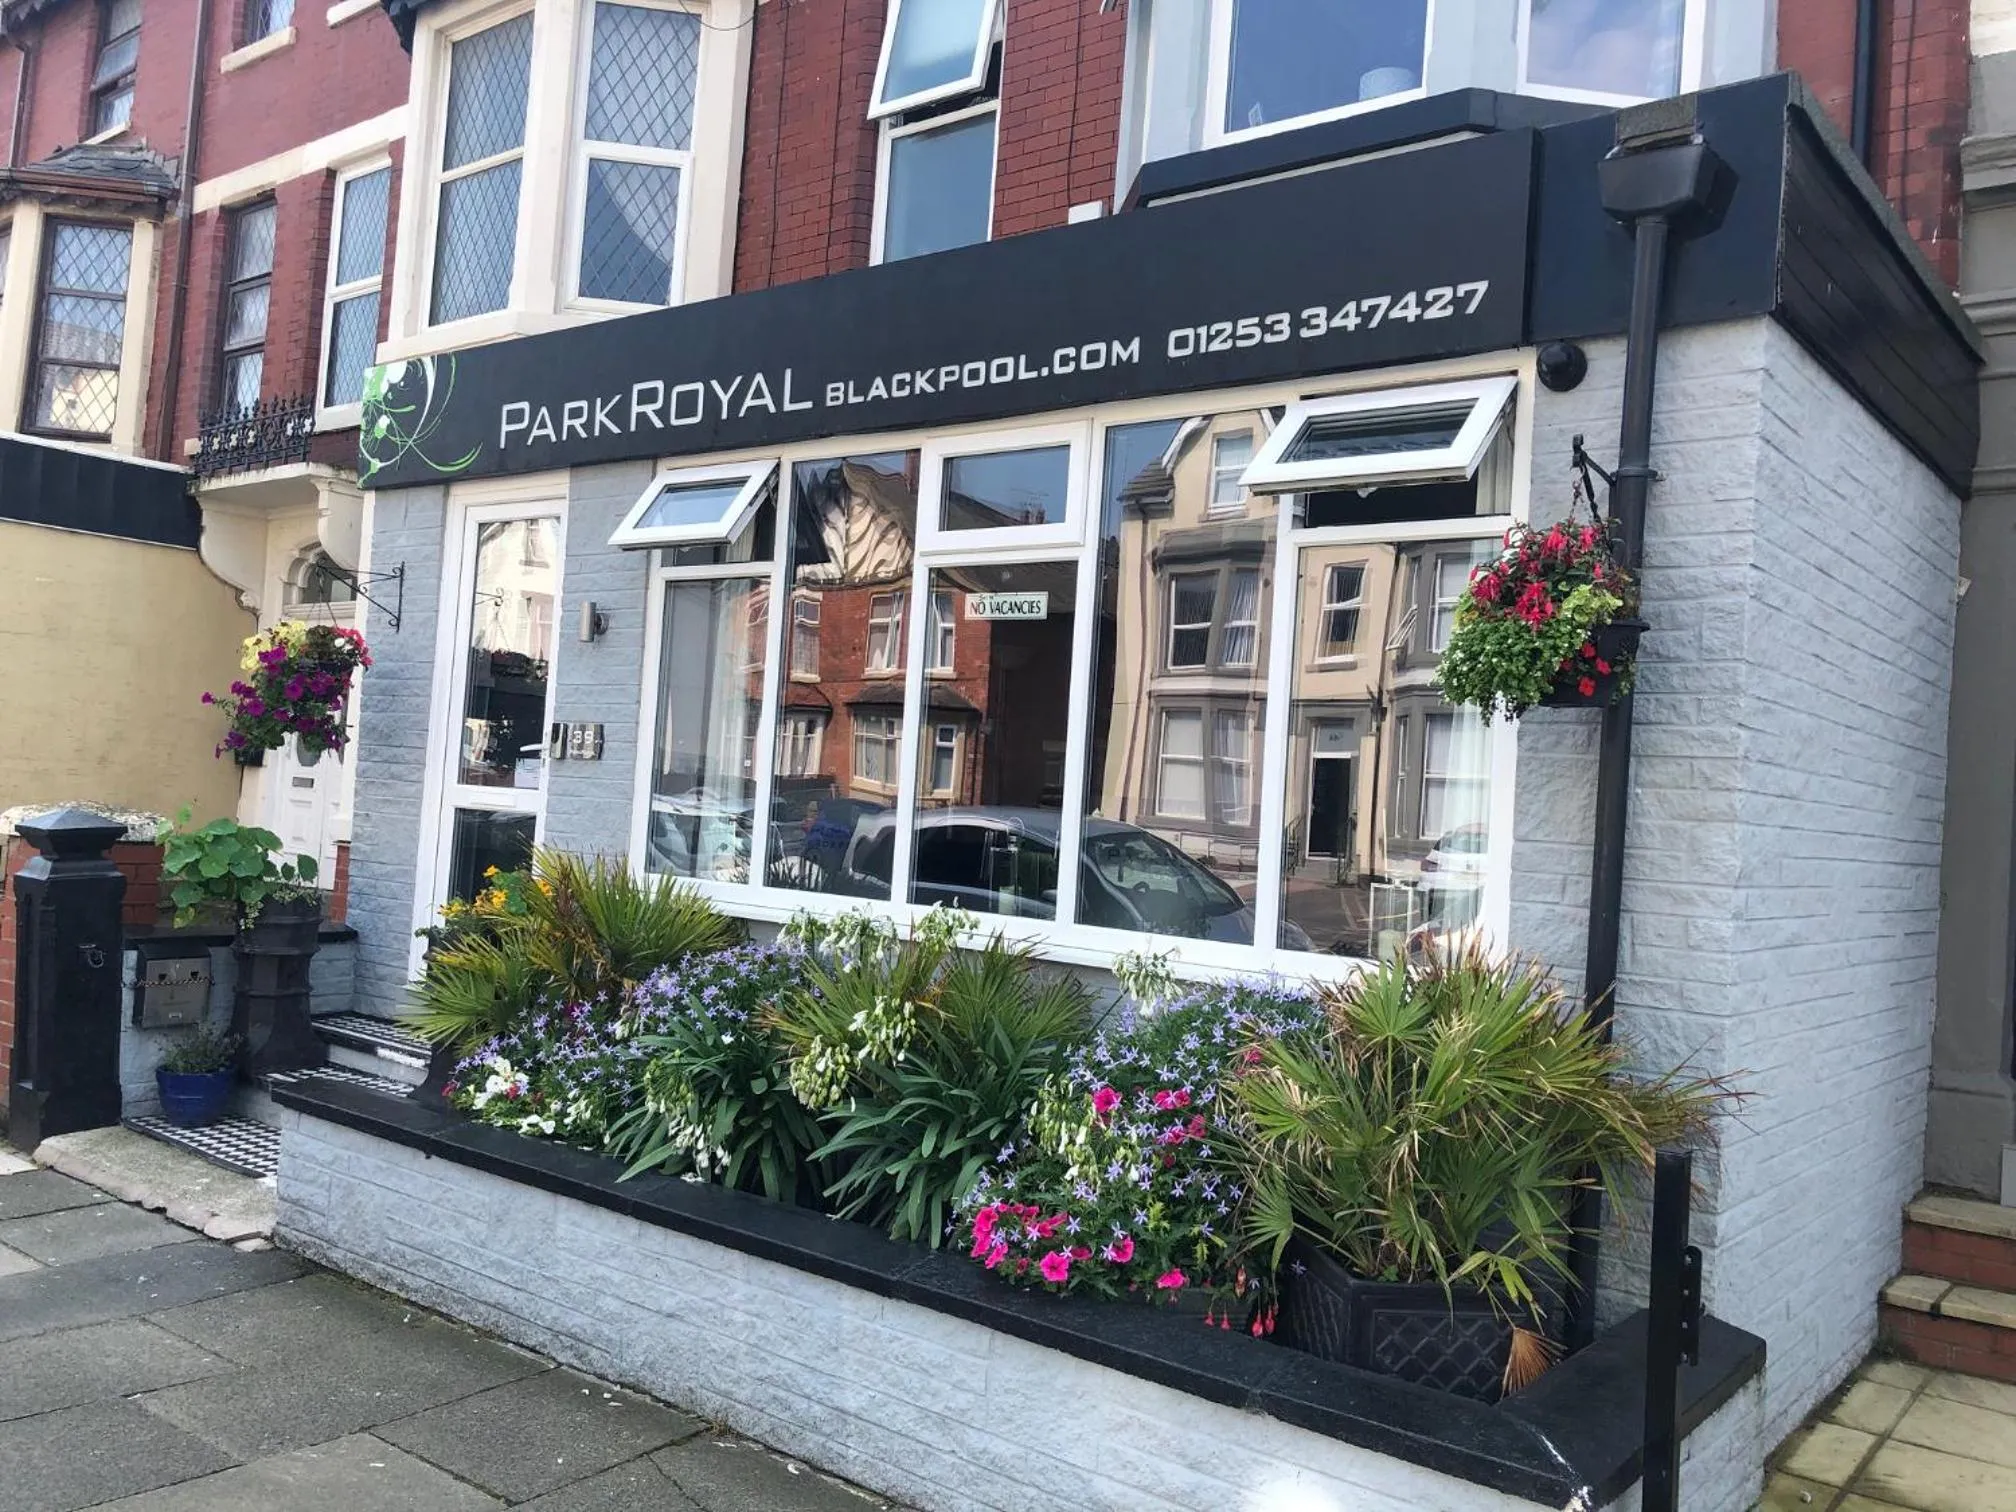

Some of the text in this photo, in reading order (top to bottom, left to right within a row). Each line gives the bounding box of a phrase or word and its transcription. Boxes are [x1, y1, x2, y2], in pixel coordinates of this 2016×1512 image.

[825, 336, 1141, 407] BLACKPOOL.COM
[1167, 312, 1291, 358] 01253
[1299, 279, 1489, 339] 347427
[970, 600, 1041, 615] NO VACANCIES
